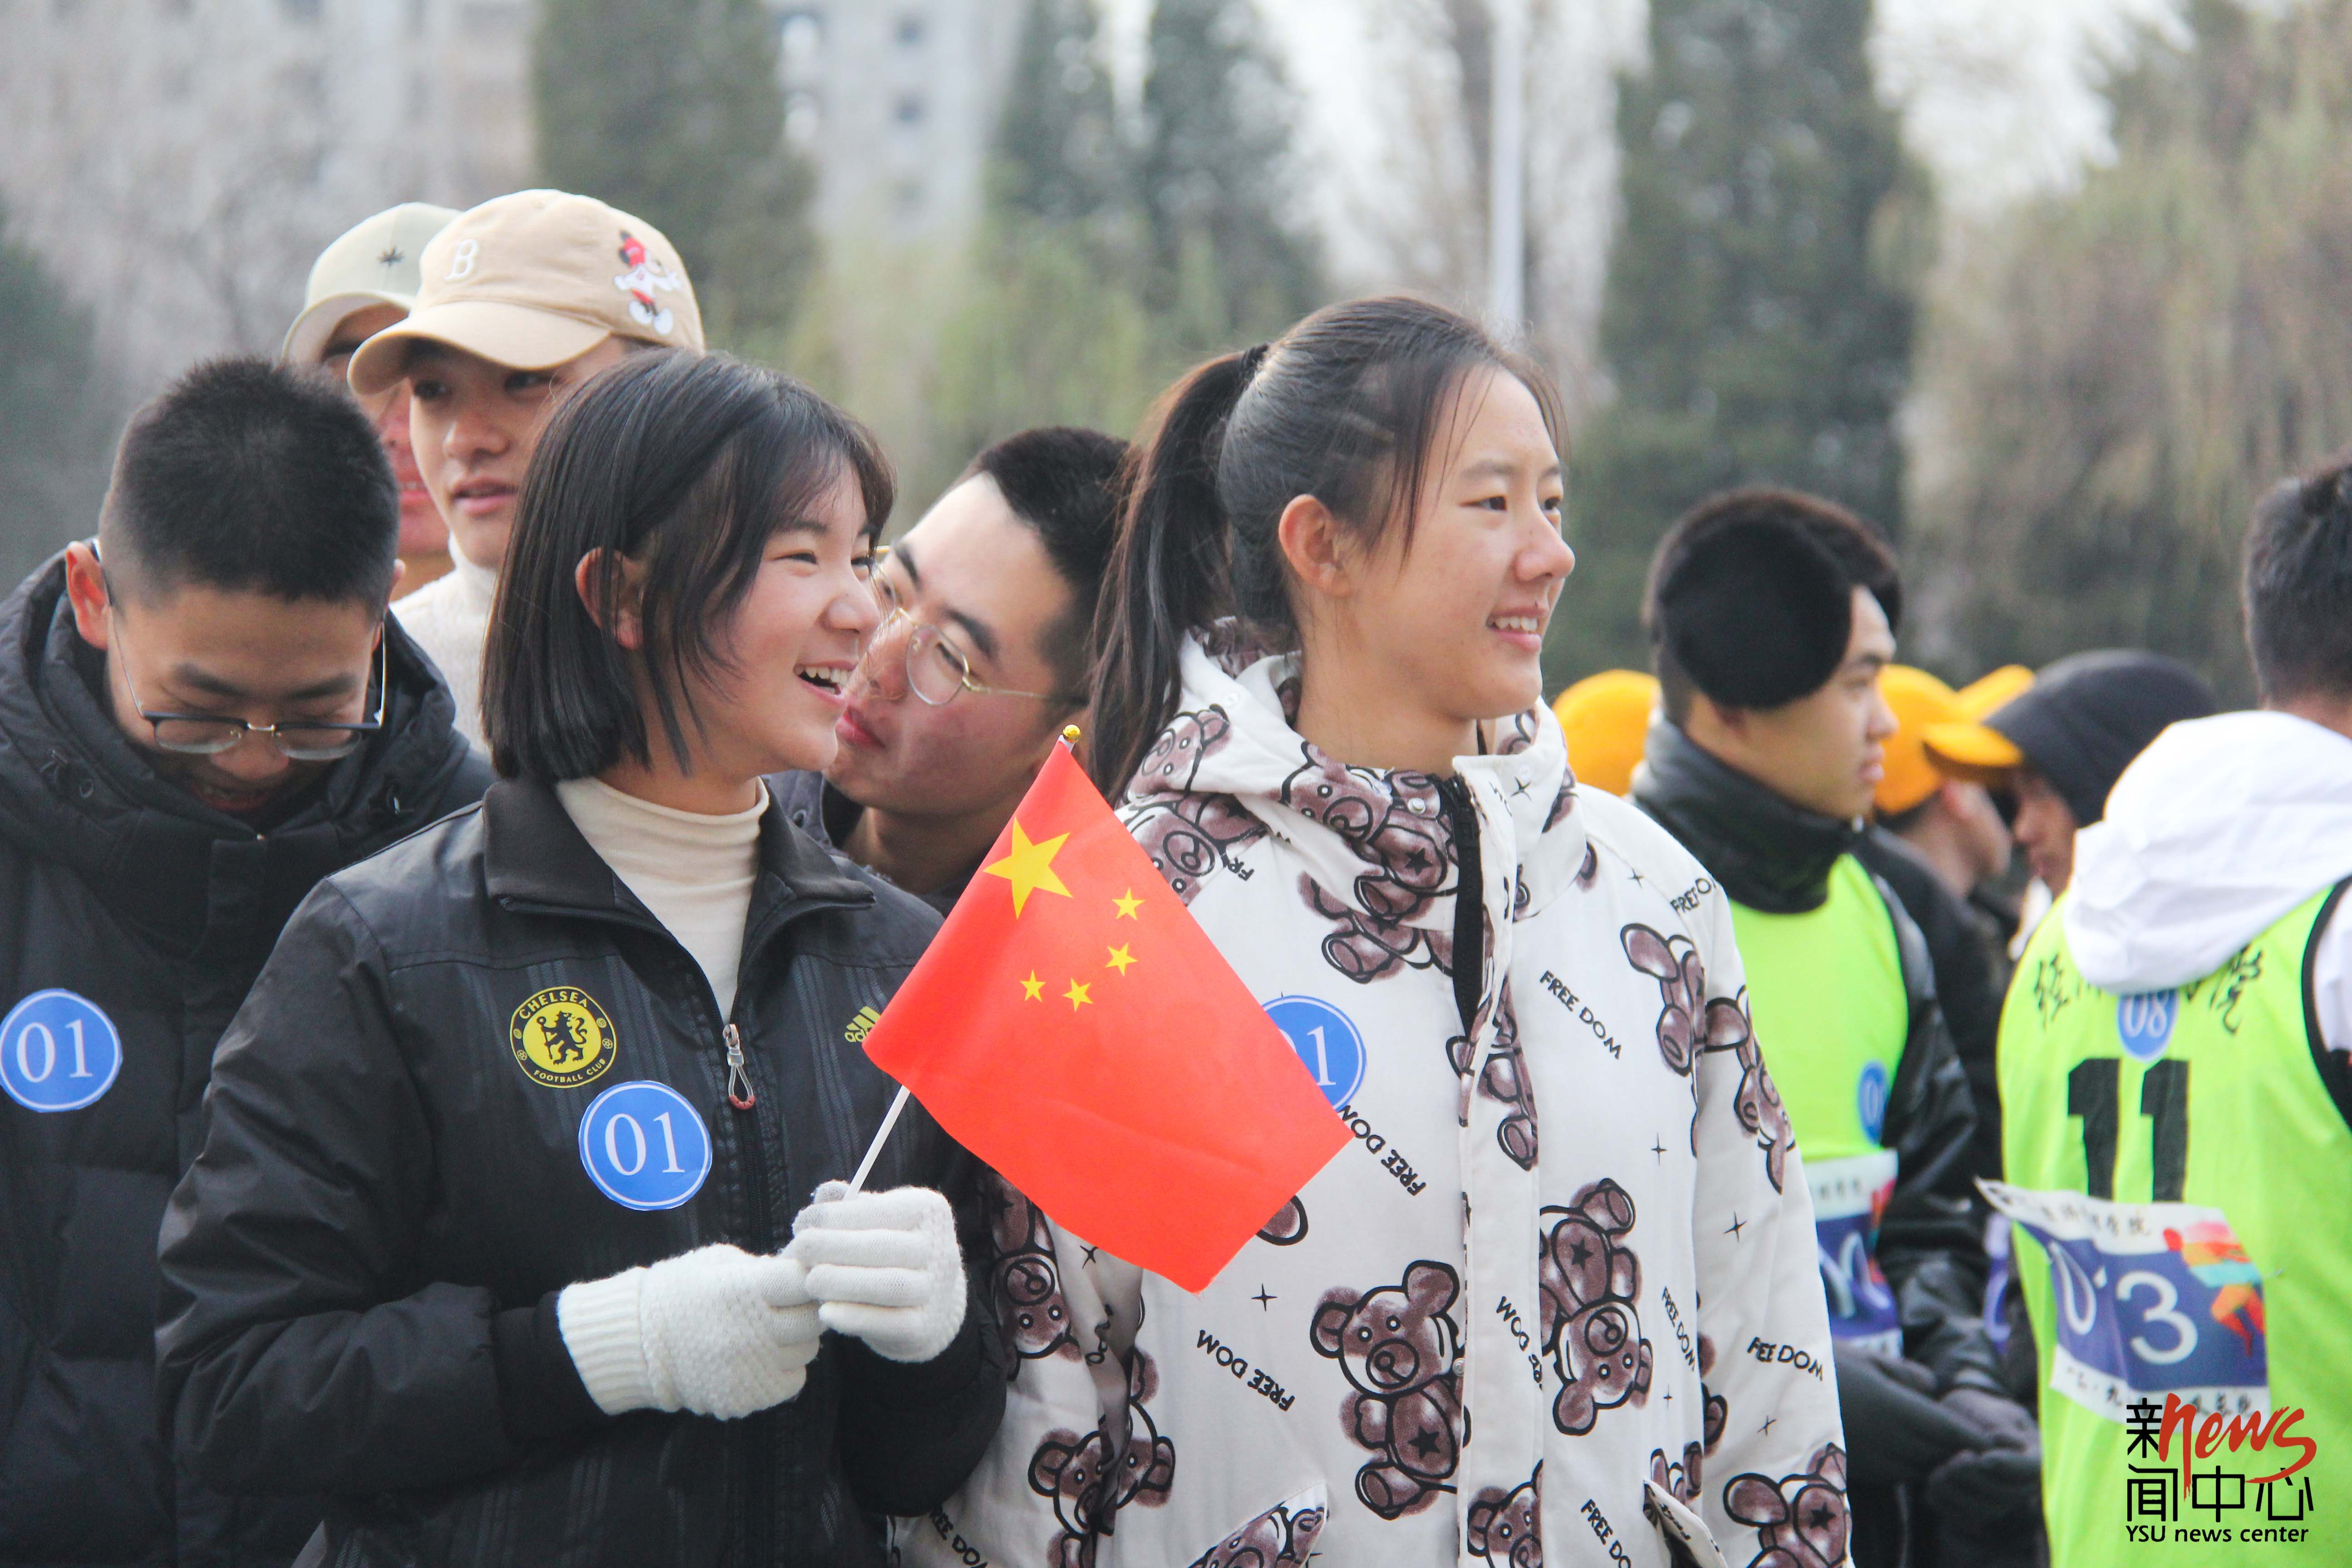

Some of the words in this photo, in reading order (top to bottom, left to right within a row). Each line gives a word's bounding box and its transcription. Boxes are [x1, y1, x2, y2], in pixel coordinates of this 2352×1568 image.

[445, 239, 479, 281] B
[519, 991, 588, 1019] CHELSEA
[1540, 970, 1580, 1012] FREE
[1579, 1007, 1622, 1059] DOM
[2123, 992, 2170, 1038] 08
[16, 1019, 93, 1083] 01
[534, 1069, 583, 1083] FOOTBALL
[586, 1058, 606, 1076] CLUB
[1279, 1025, 1337, 1086] 1
[605, 1112, 685, 1176] 01
[2068, 1058, 2191, 1201] 11
[1381, 1149, 1427, 1196] FREE
[1197, 1329, 1248, 1379] DOM
[1677, 1321, 1695, 1372] DOM
[1777, 1344, 1823, 1382] DOM
[1247, 1369, 1295, 1412] FREE
[1581, 1499, 1614, 1545] FREE
